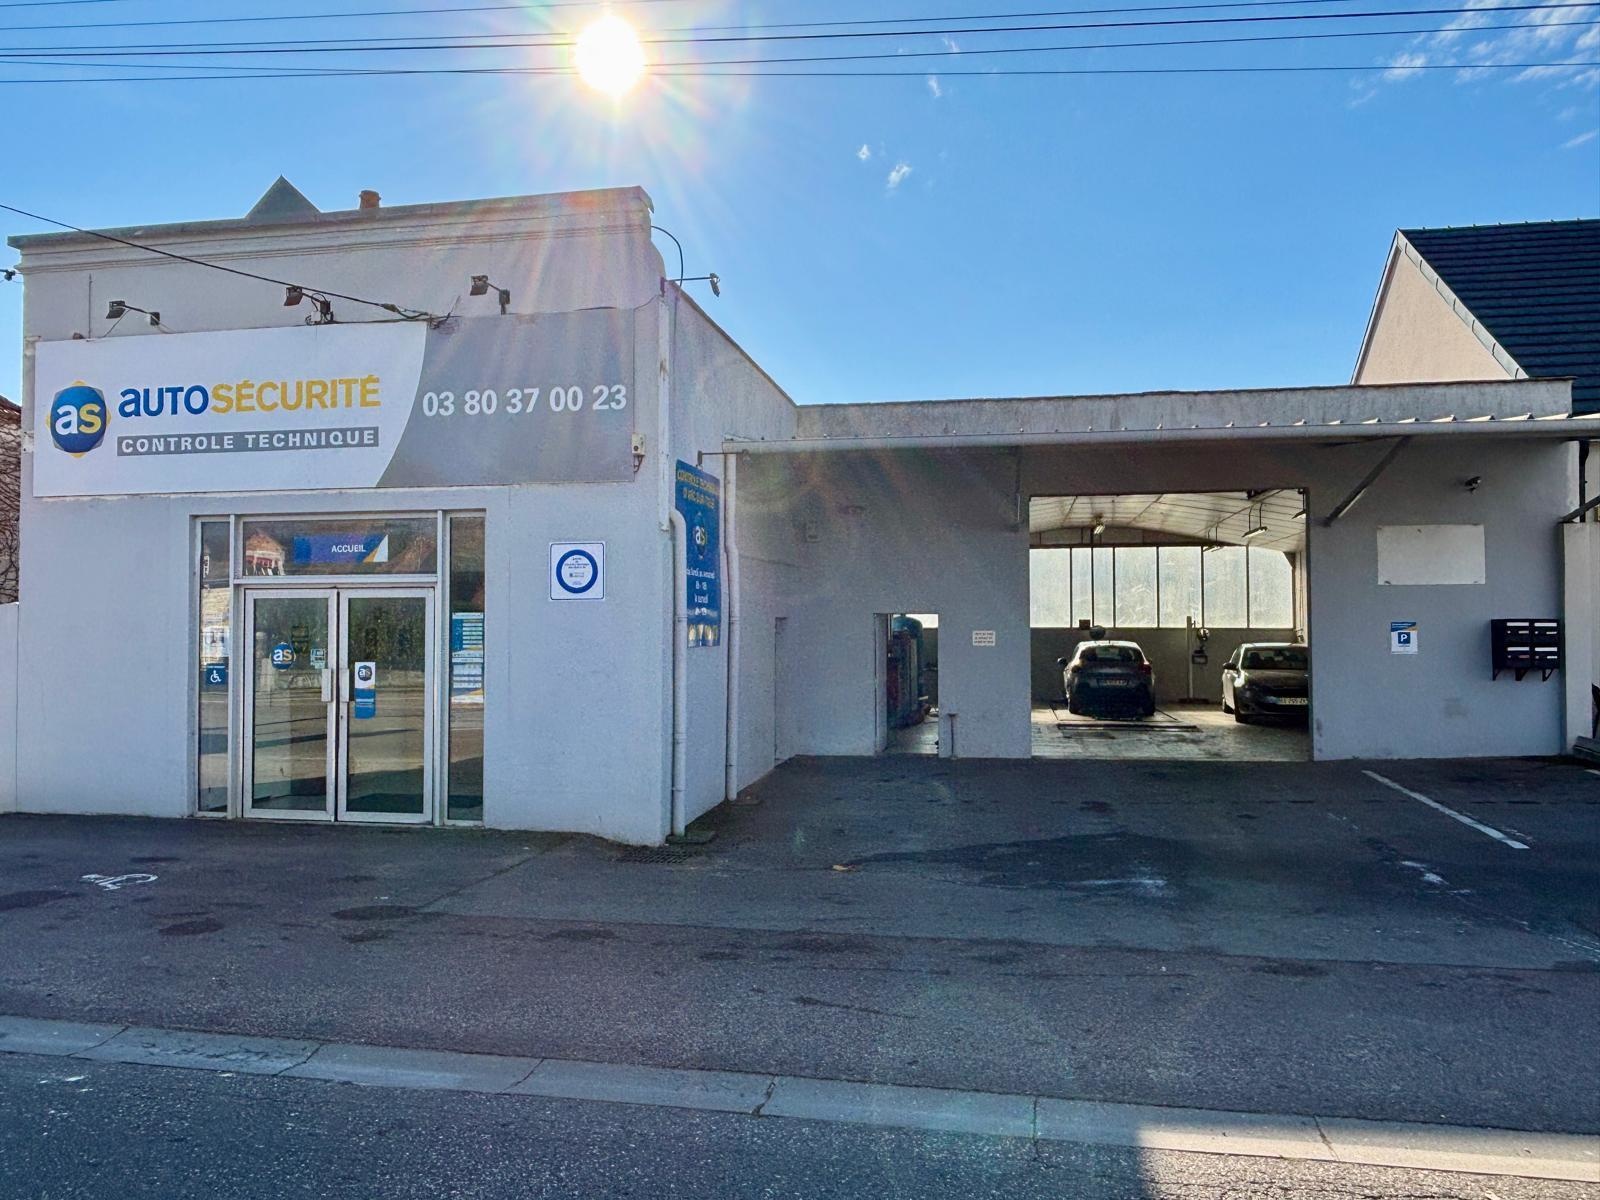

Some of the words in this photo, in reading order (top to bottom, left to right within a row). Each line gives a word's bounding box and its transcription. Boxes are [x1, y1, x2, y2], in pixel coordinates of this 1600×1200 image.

[422, 391, 455, 417] 03
[464, 389, 498, 415] 80
[506, 387, 540, 414] 37
[549, 386, 584, 412] 00
[592, 384, 627, 410] 23
[55, 403, 102, 436] as
[121, 435, 235, 453] CONTROLE
[244, 430, 375, 448] TECHNIQUE
[331, 544, 367, 553] ACCUEIL
[273, 648, 293, 661] as
